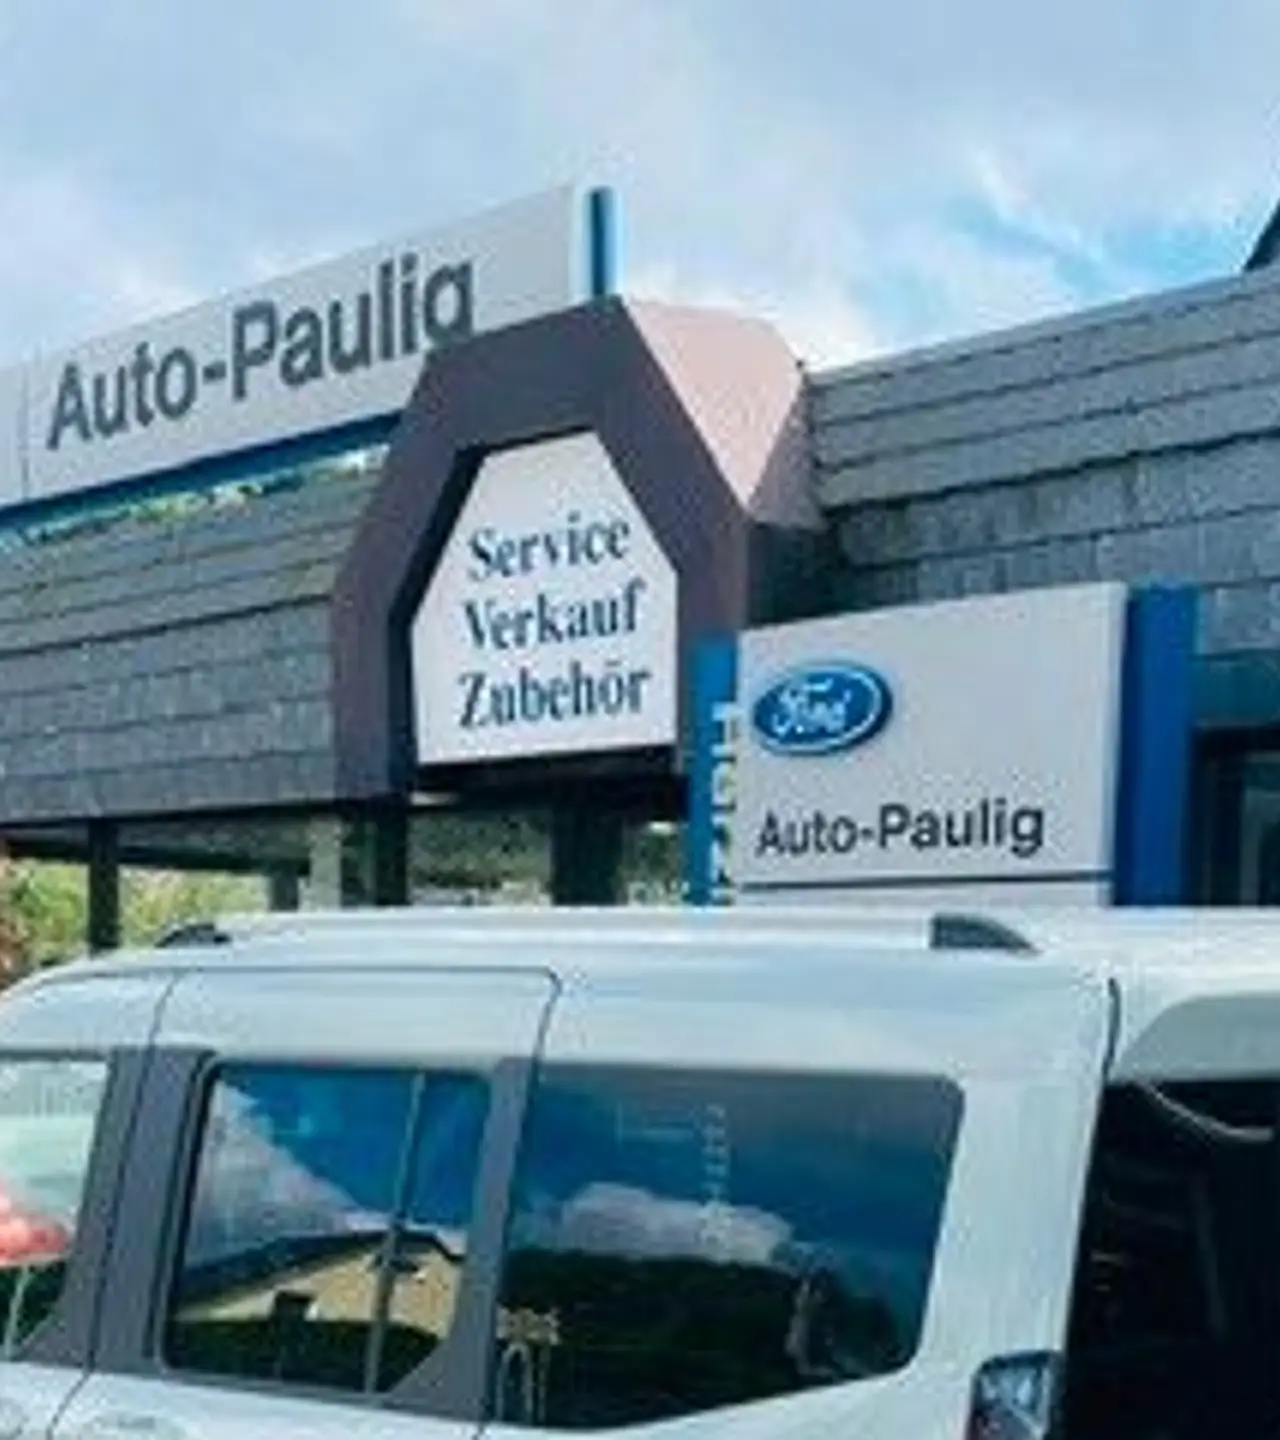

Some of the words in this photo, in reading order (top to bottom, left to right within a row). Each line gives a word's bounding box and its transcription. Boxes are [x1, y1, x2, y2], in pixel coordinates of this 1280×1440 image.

[468, 512, 631, 581] Service
[463, 575, 646, 649] Verkauf
[457, 659, 652, 727] Zubehör
[754, 798, 1045, 858] Auto-Paulig
